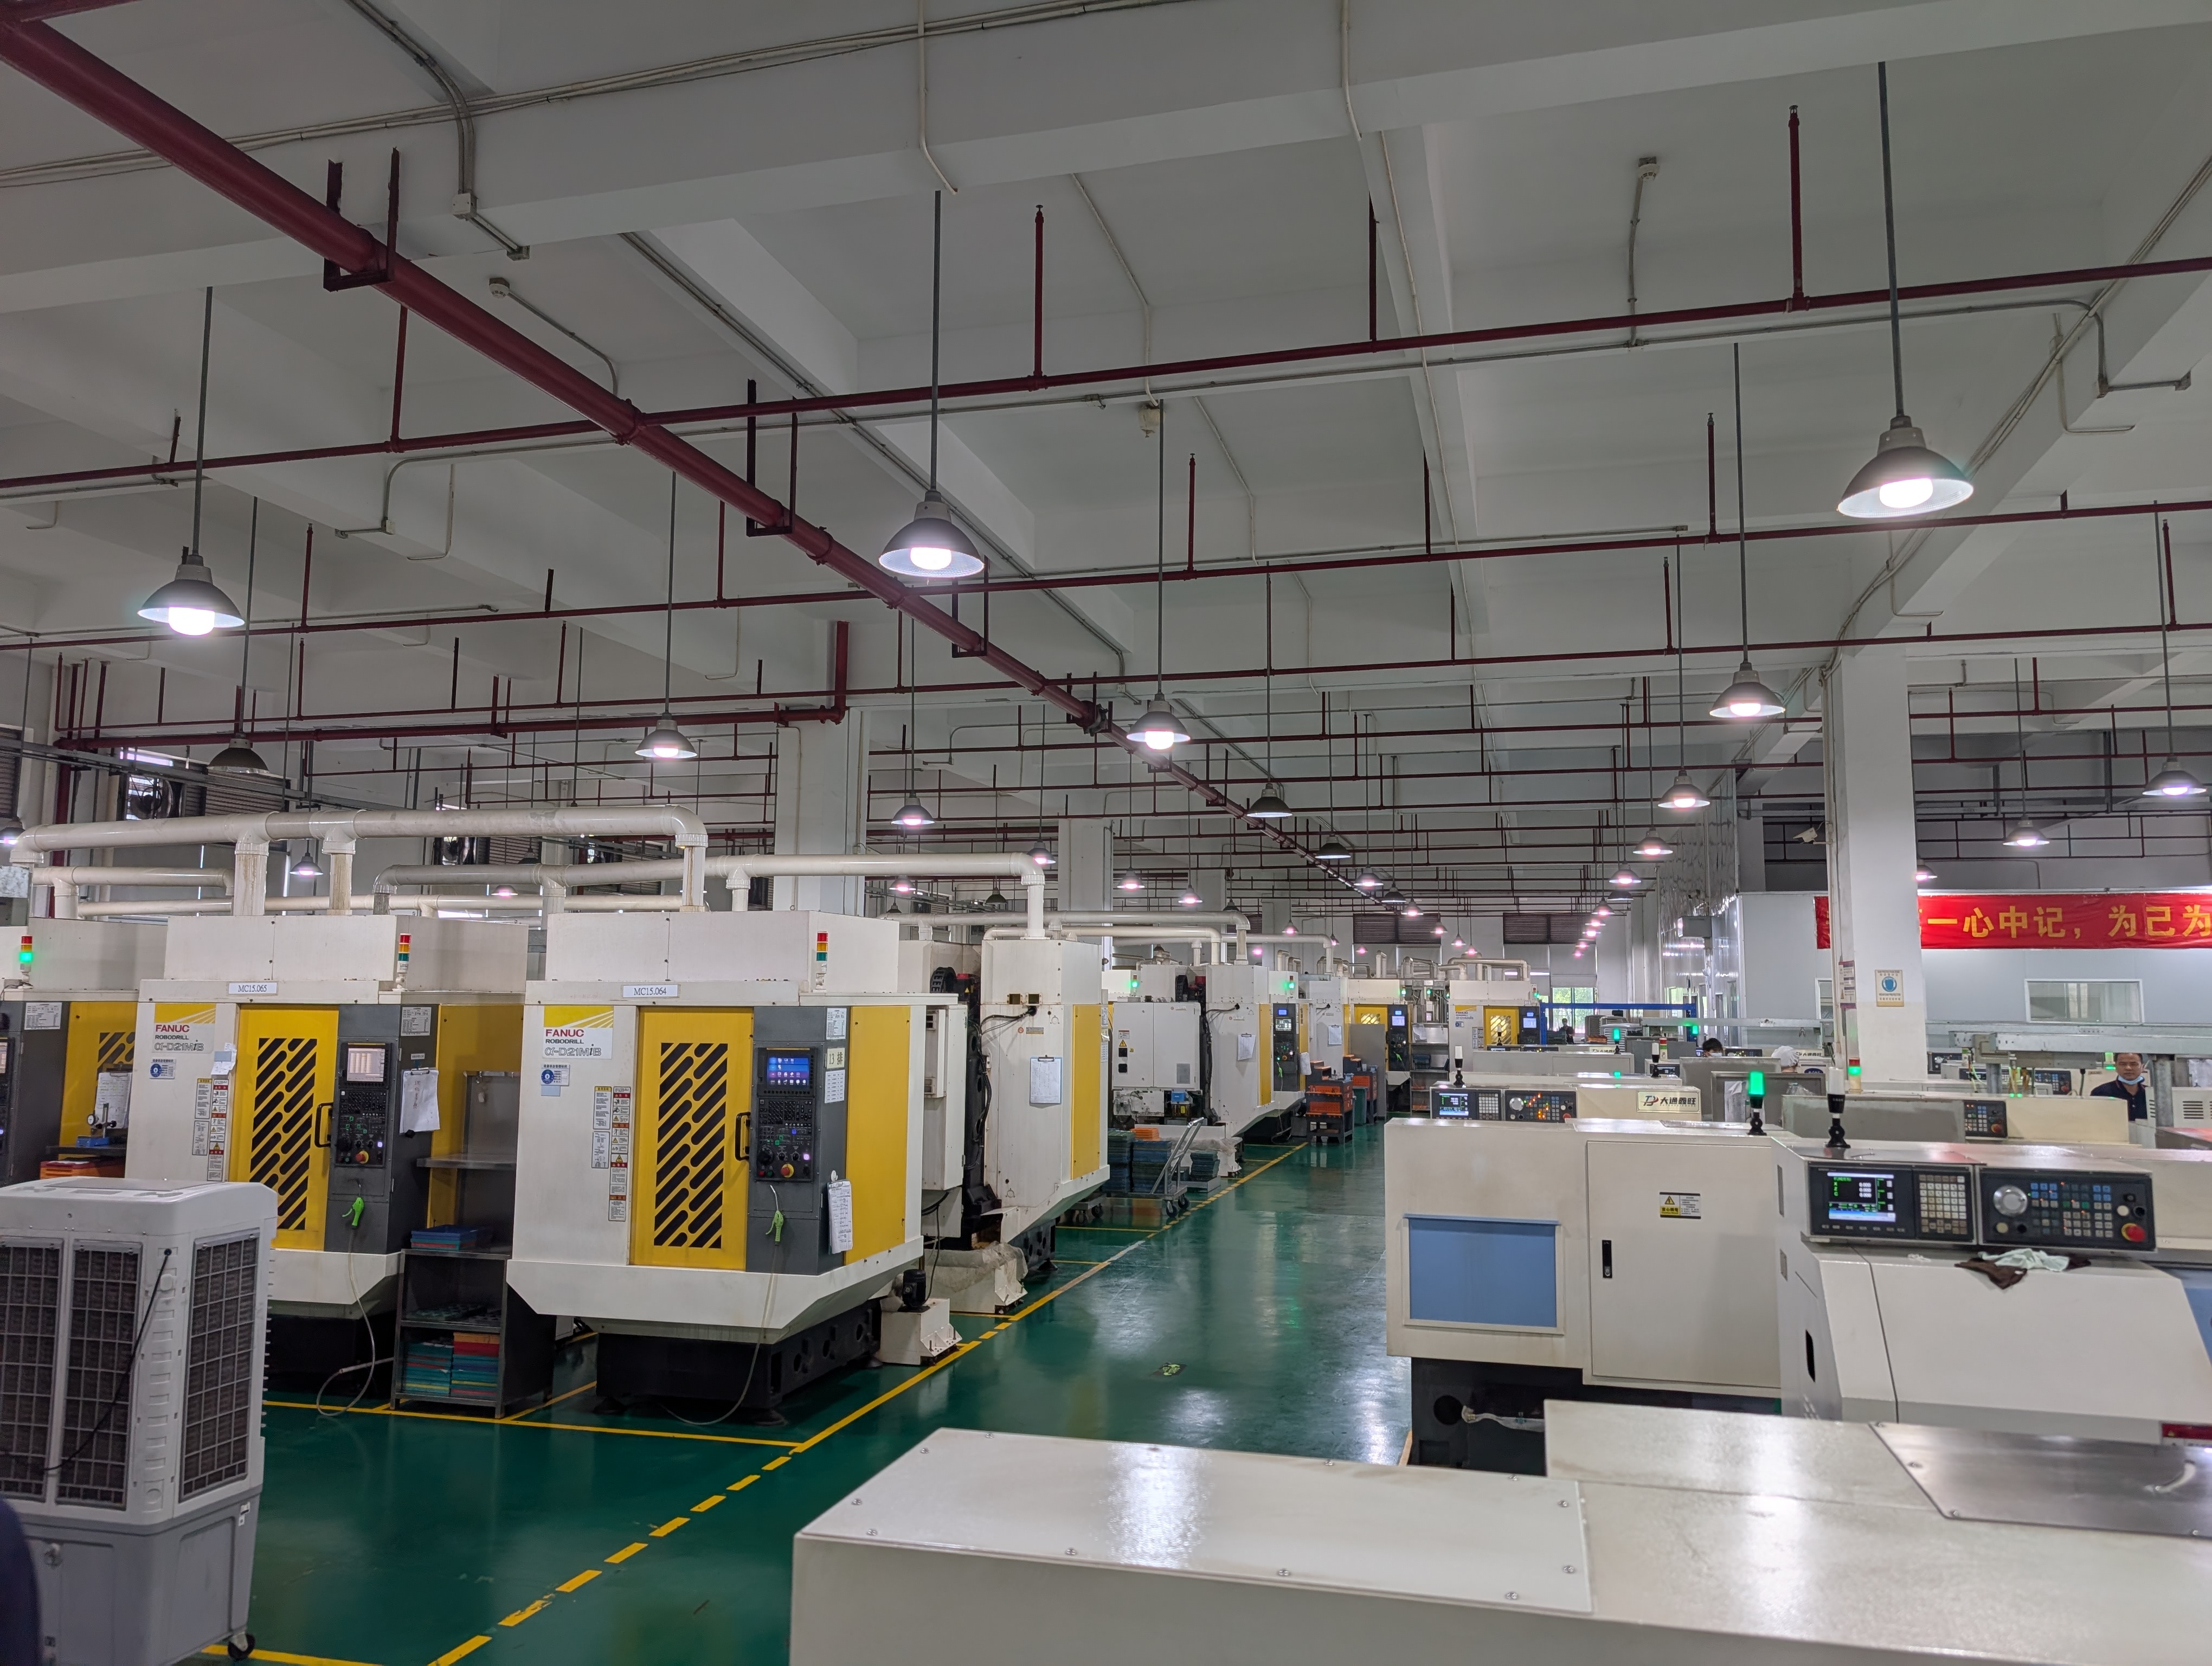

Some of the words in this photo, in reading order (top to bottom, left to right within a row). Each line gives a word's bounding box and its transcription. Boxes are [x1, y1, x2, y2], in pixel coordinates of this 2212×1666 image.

[1920, 905, 2211, 939] 一心中记，为己为
[634, 987, 666, 996] MC15.064
[156, 1024, 190, 1033] FANUC
[545, 1029, 584, 1037] FANUC
[829, 1054, 834, 1065] 13
